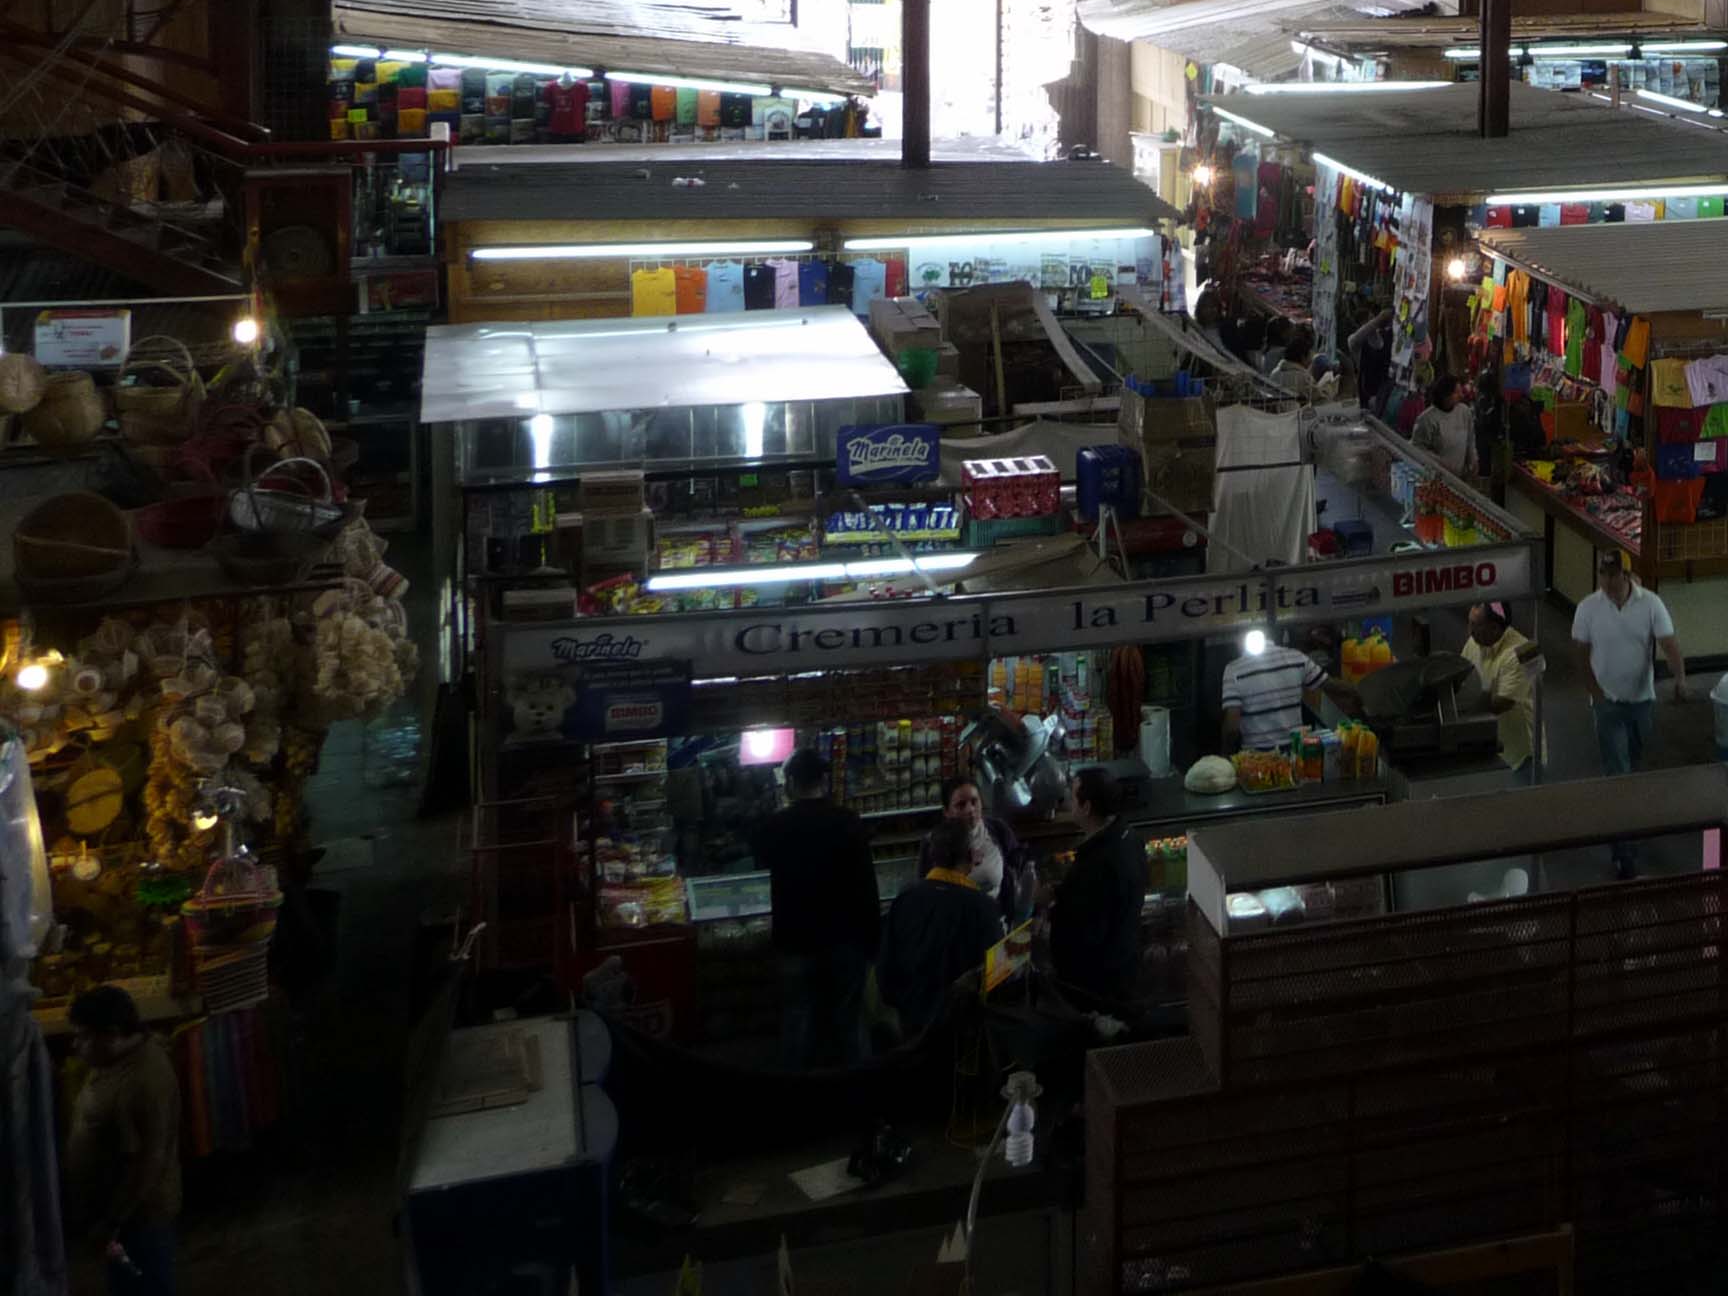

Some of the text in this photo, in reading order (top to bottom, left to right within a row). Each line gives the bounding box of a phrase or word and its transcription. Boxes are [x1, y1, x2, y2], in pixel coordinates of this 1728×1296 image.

[846, 434, 931, 463] Marinela
[1393, 561, 1497, 598] BIMBO
[736, 584, 1319, 655] Cremeria la Perlita
[552, 633, 642, 661] Marinela
